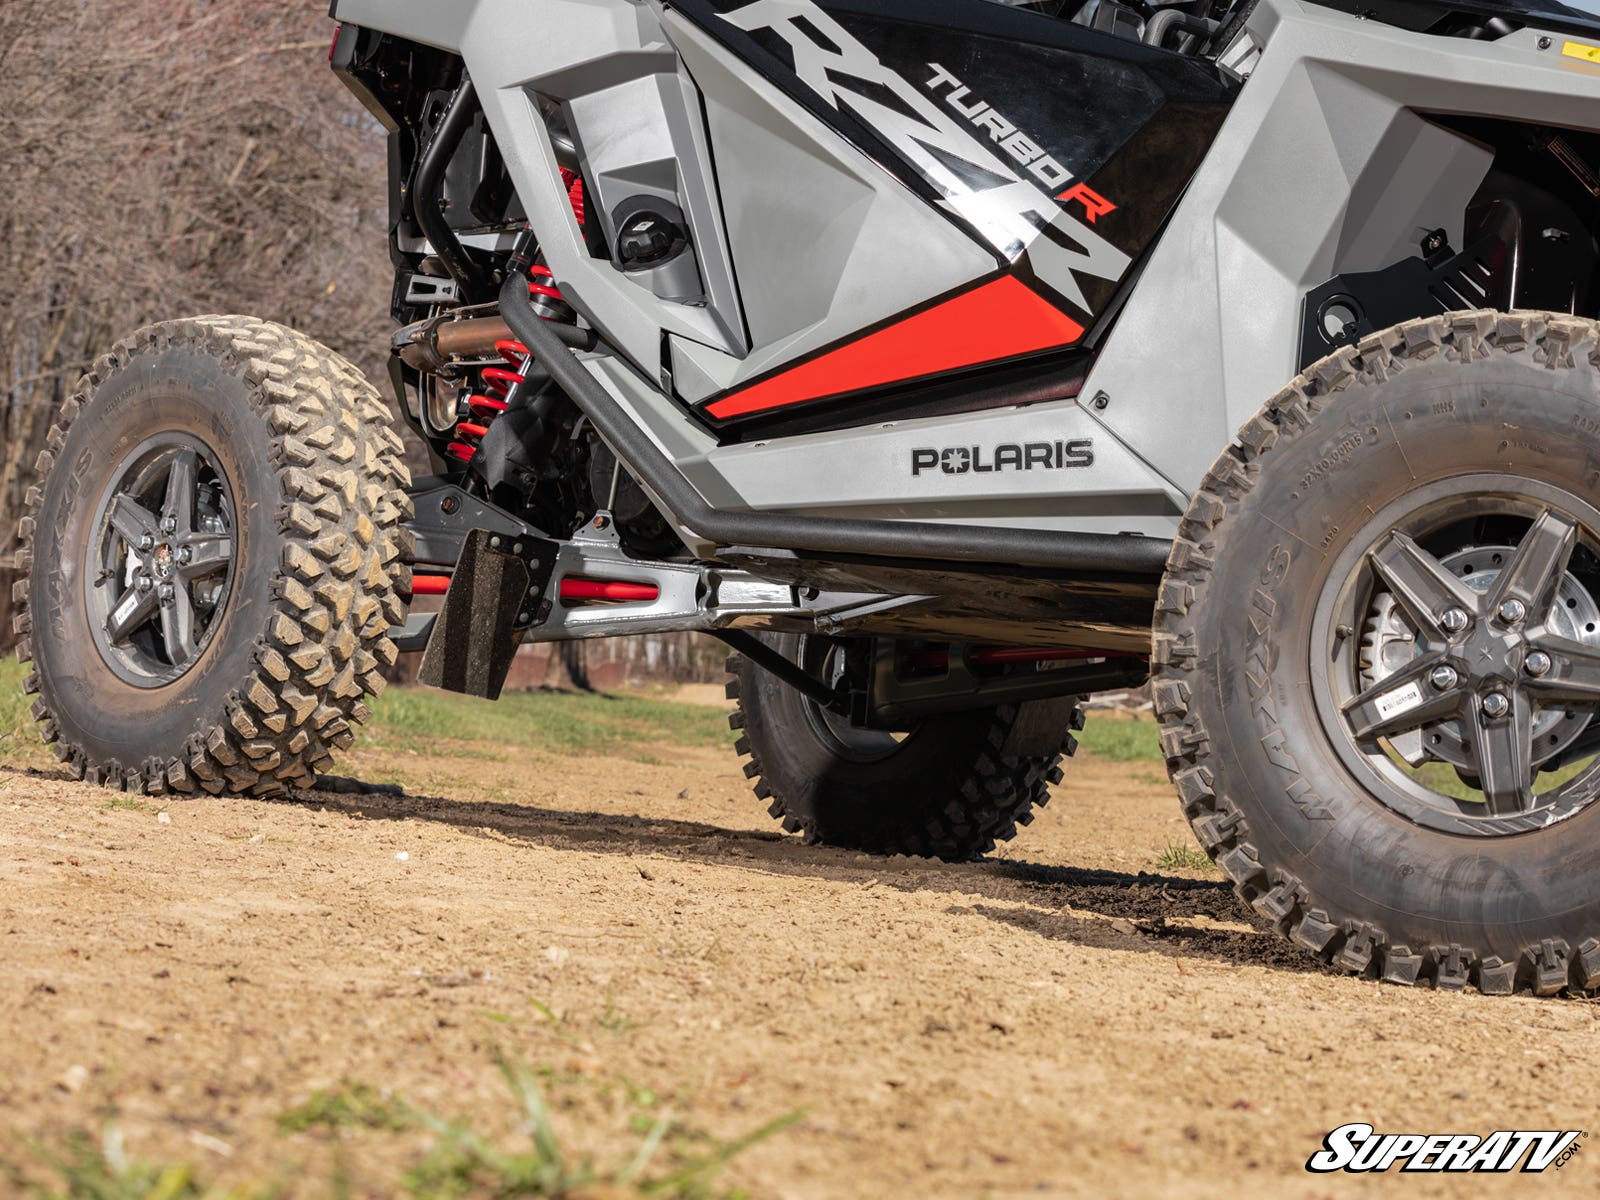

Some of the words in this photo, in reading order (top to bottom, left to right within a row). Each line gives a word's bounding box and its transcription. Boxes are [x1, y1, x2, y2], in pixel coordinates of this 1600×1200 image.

[713, 0, 1133, 318] RZR
[925, 62, 1075, 190] TURBO
[1054, 181, 1119, 224] R
[48, 446, 95, 641] MAXXIS
[911, 439, 1095, 476] POLARIS
[1245, 543, 1336, 820] MAXXIS
